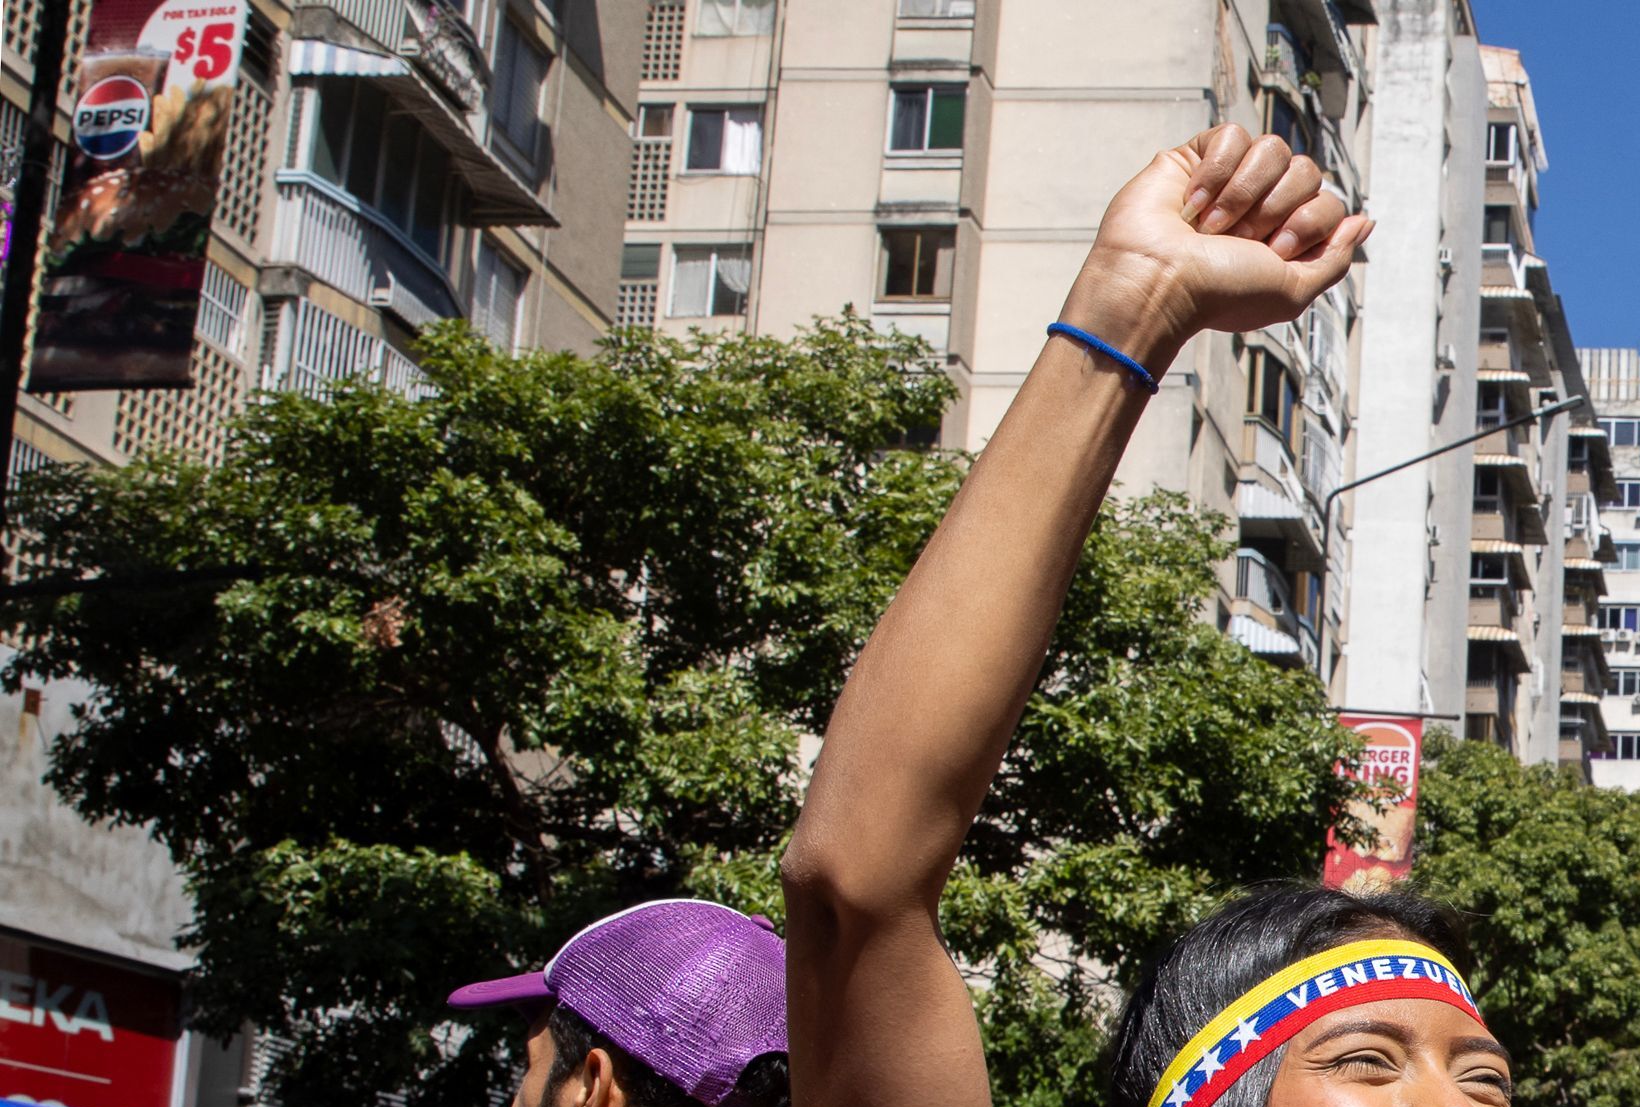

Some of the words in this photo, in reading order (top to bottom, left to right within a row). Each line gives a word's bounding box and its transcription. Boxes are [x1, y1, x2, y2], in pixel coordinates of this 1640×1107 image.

[175, 23, 234, 80] $5
[78, 109, 144, 127] PEPSI
[1361, 749, 1410, 764] RGER
[1344, 764, 1409, 786] ING
